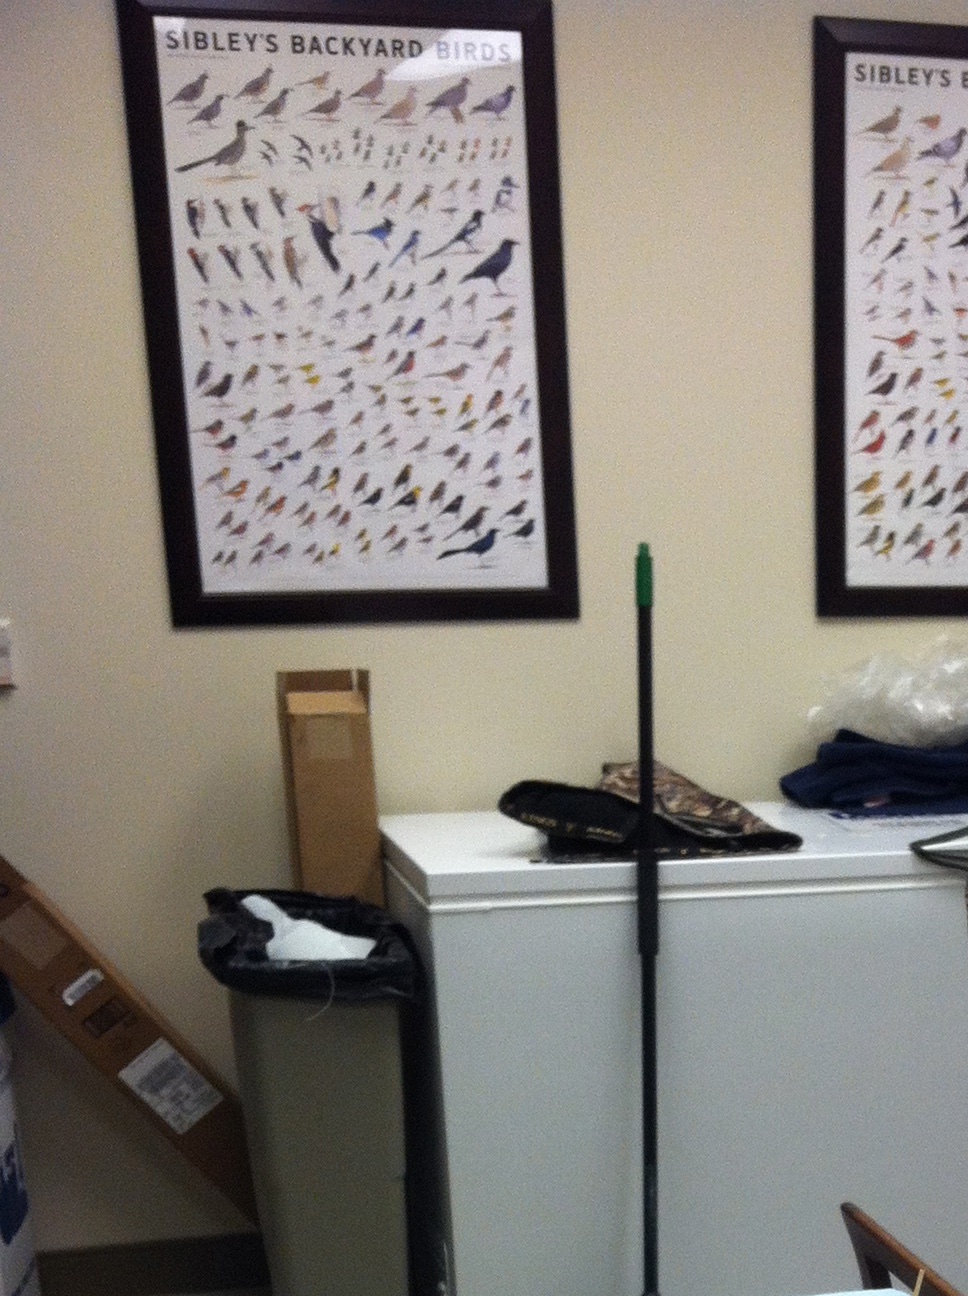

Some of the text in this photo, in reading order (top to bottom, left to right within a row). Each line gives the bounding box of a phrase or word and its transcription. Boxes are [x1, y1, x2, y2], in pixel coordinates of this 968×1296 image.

[165, 30, 512, 61] SIBLEY'S BACKYARD BIRDS
[854, 63, 951, 87] SIBLEY'S
